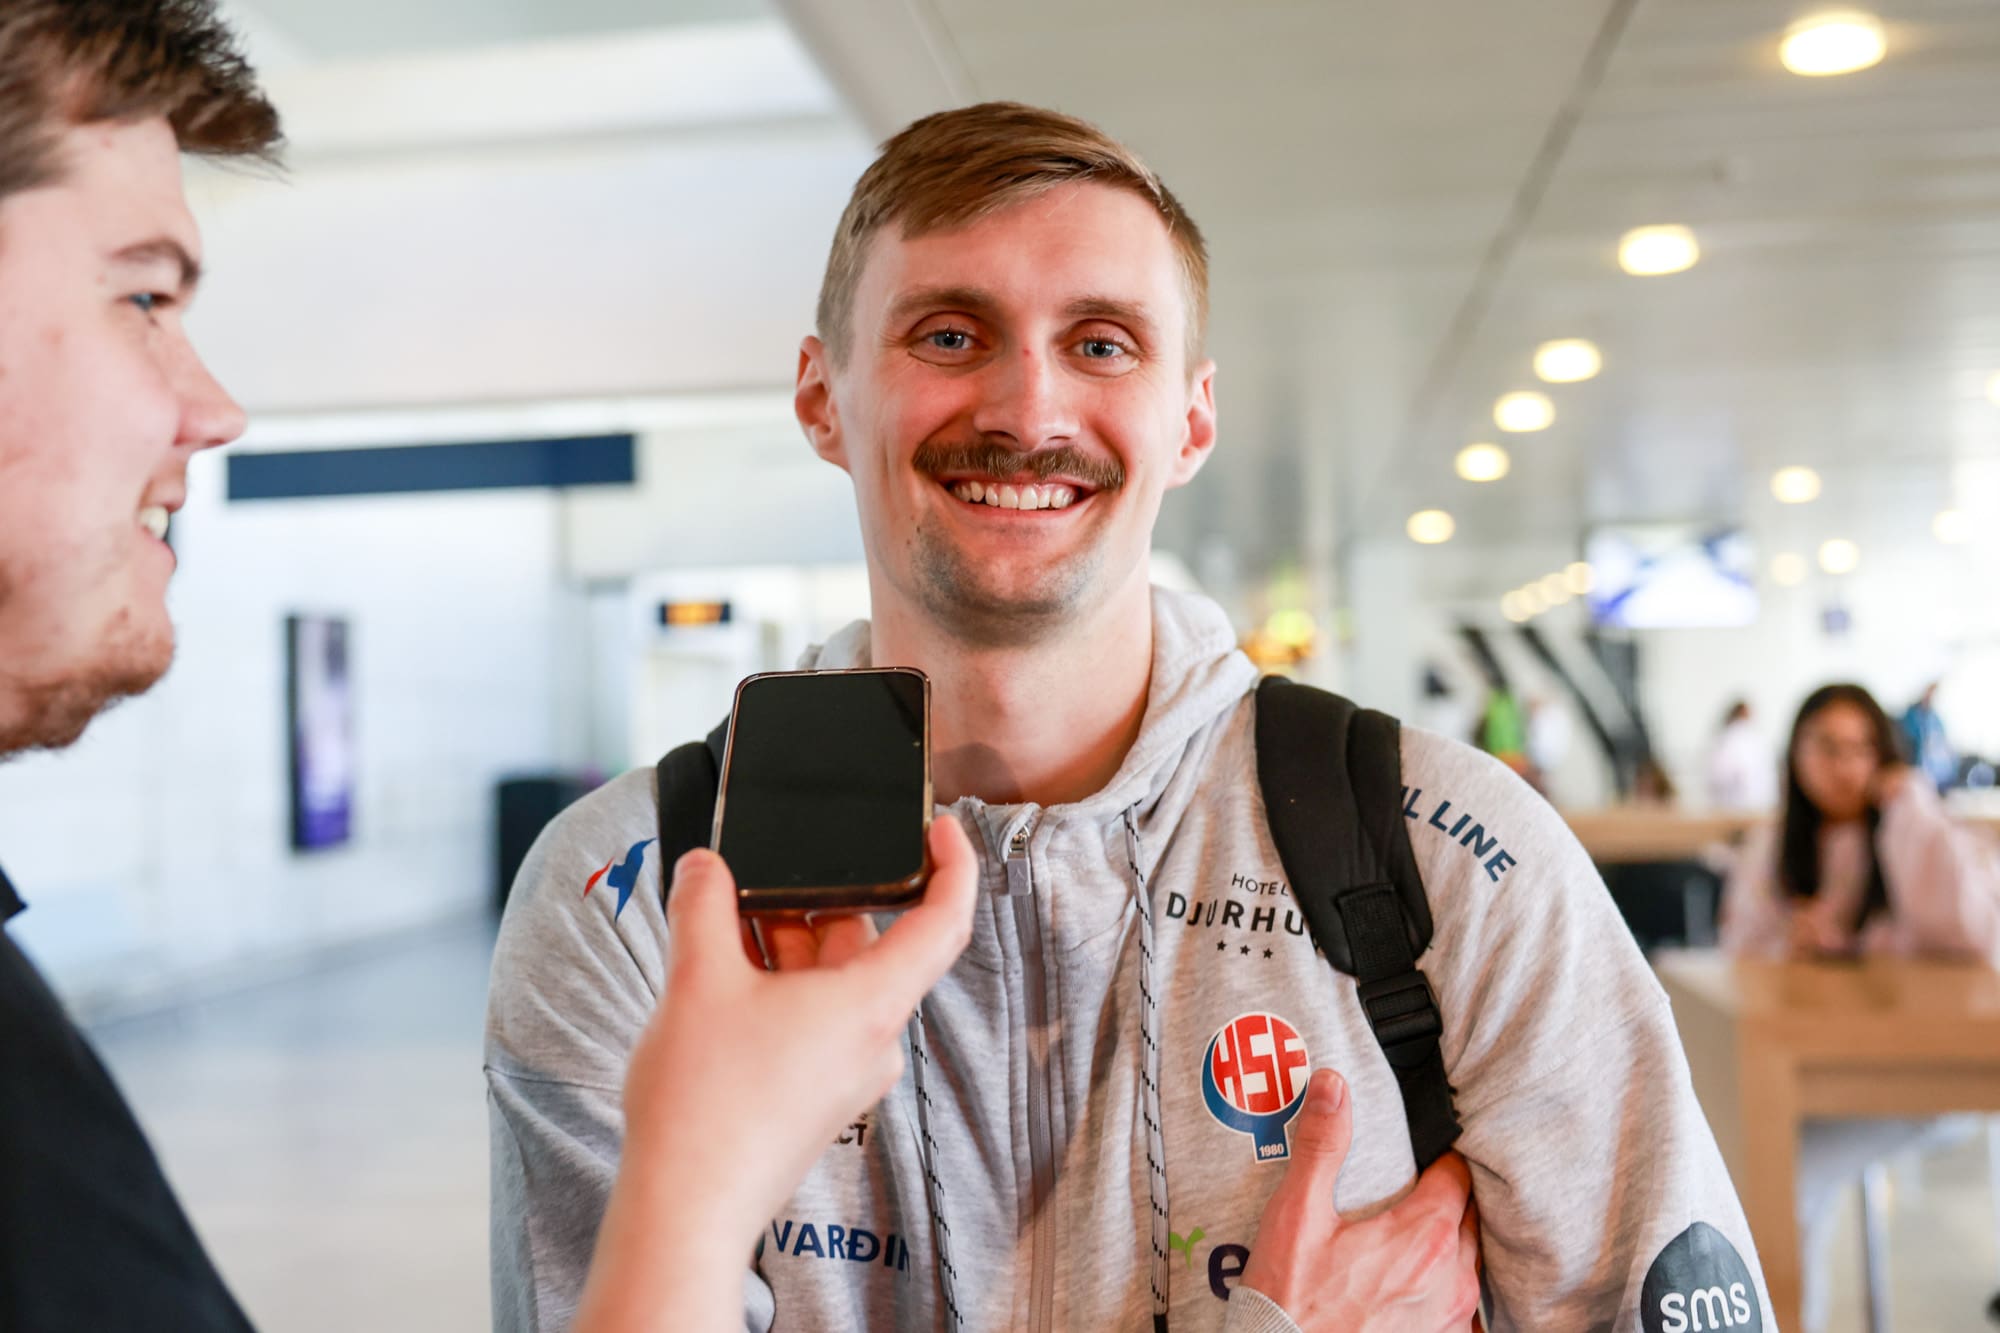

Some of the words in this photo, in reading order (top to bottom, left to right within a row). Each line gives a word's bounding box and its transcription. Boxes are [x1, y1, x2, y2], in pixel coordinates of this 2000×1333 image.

[1428, 800, 1518, 882] LINE
[1231, 873, 1290, 897] HOTEL
[1211, 1014, 1307, 1113] HSF
[1258, 1142, 1285, 1158] 1980
[1659, 1282, 1751, 1333] sms
